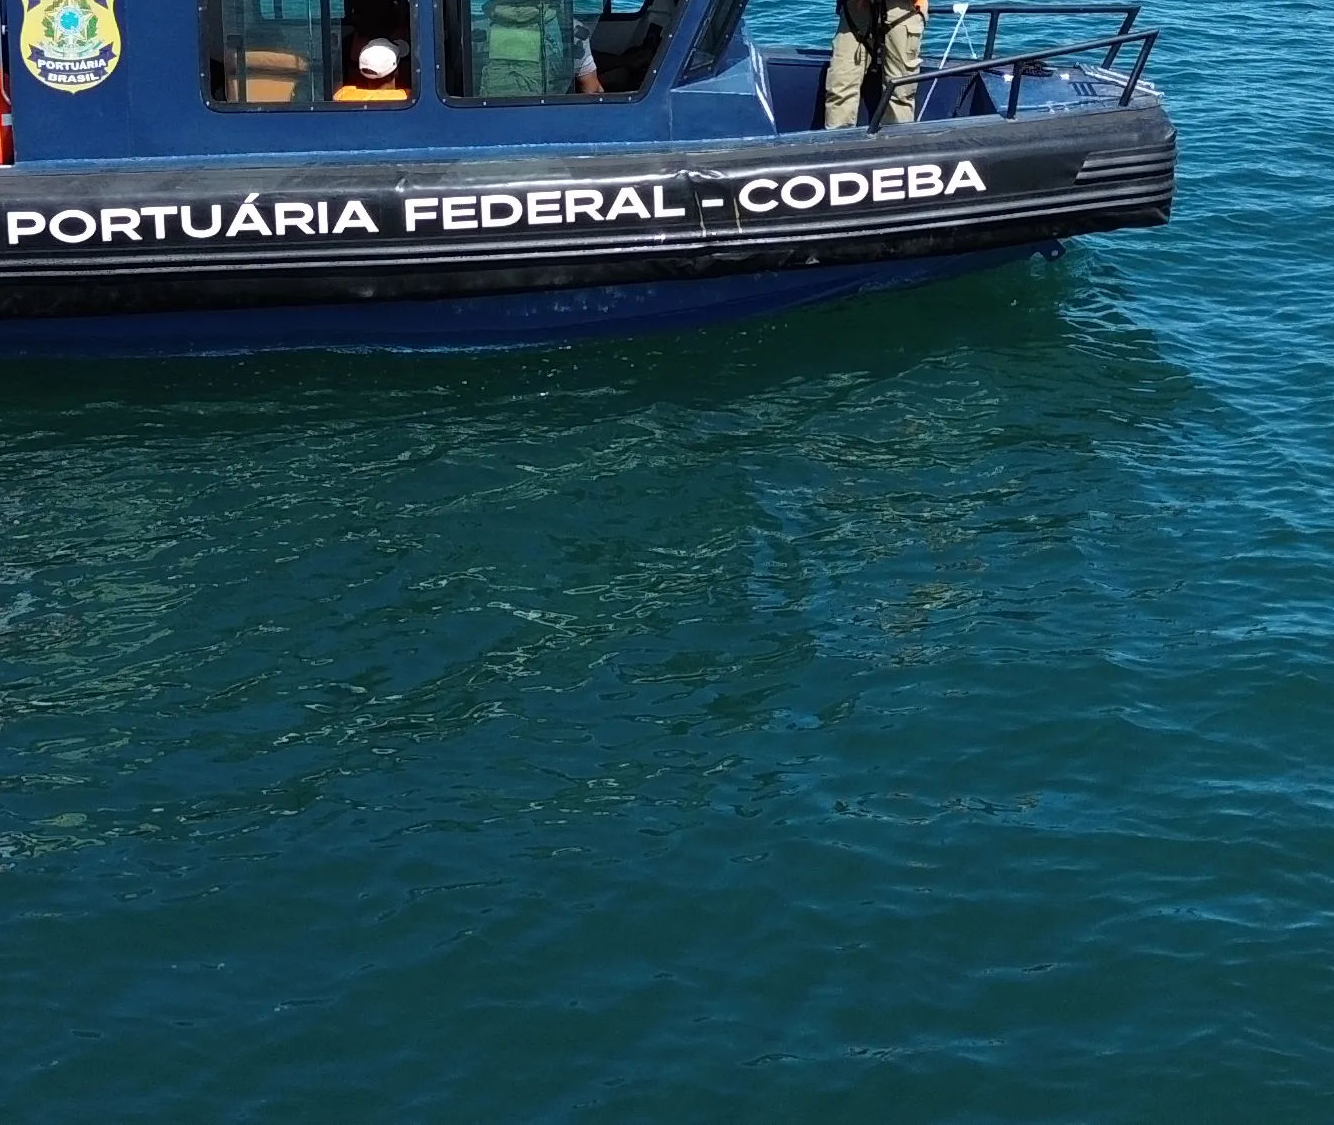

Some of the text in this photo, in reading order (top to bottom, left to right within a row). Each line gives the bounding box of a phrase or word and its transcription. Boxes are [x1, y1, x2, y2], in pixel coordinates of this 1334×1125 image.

[37, 58, 107, 71] PORTUÁRIA
[47, 72, 100, 83] BRASIL
[6, 192, 380, 245] PORTUÁRIA
[404, 185, 686, 232] FEDERAL
[738, 160, 987, 213] CODEBA
